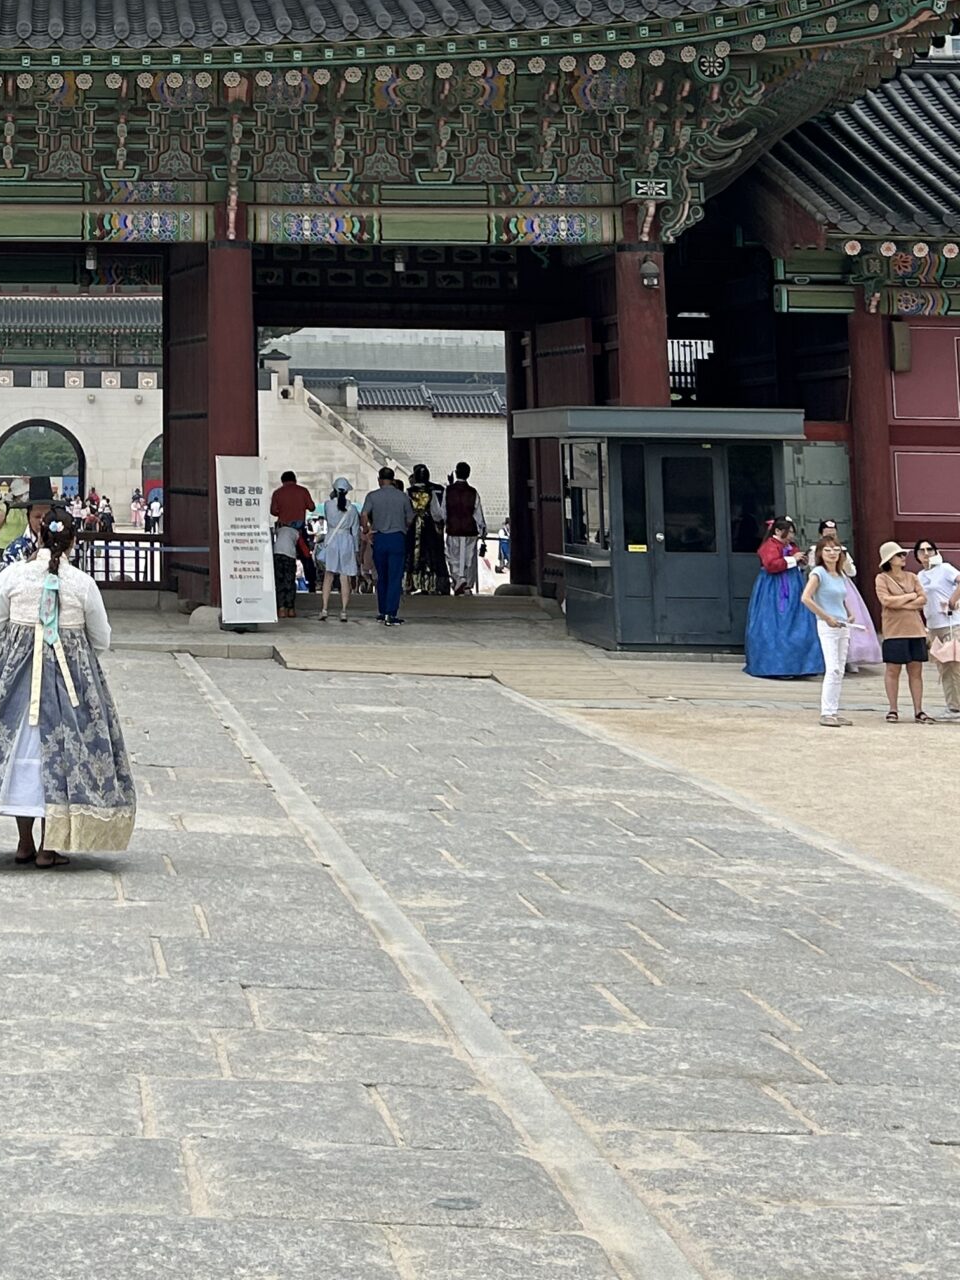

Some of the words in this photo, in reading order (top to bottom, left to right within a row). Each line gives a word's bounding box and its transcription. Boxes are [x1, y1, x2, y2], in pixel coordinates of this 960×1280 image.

[223, 485, 246, 495] 경복궁
[247, 485, 263, 495] 관람
[227, 497, 243, 507] 관련
[244, 497, 260, 507] 공지
